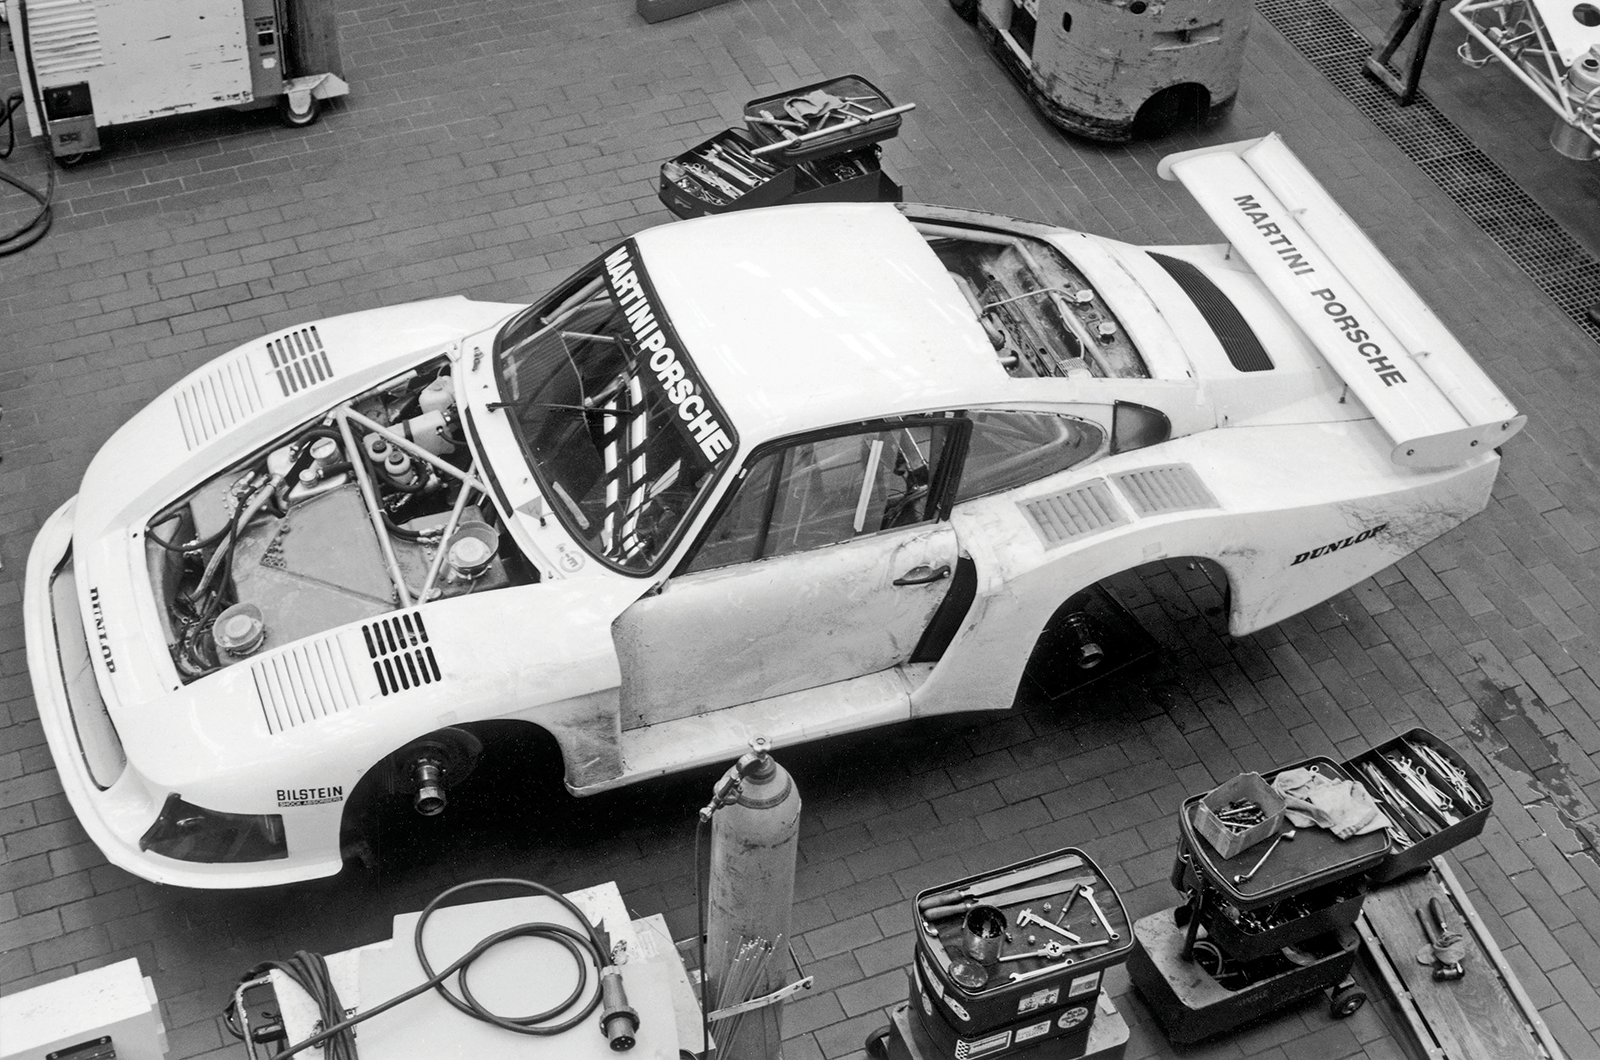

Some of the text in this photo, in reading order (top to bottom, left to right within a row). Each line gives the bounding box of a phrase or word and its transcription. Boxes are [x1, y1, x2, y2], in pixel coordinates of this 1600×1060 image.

[1233, 194, 1407, 387] MARTINI PORSCHE
[604, 246, 733, 463] MARTINI PORSCHE
[1290, 521, 1389, 566] DUNLOP
[90, 586, 116, 673] DUNLOP
[276, 786, 343, 801] BILSTEIN
